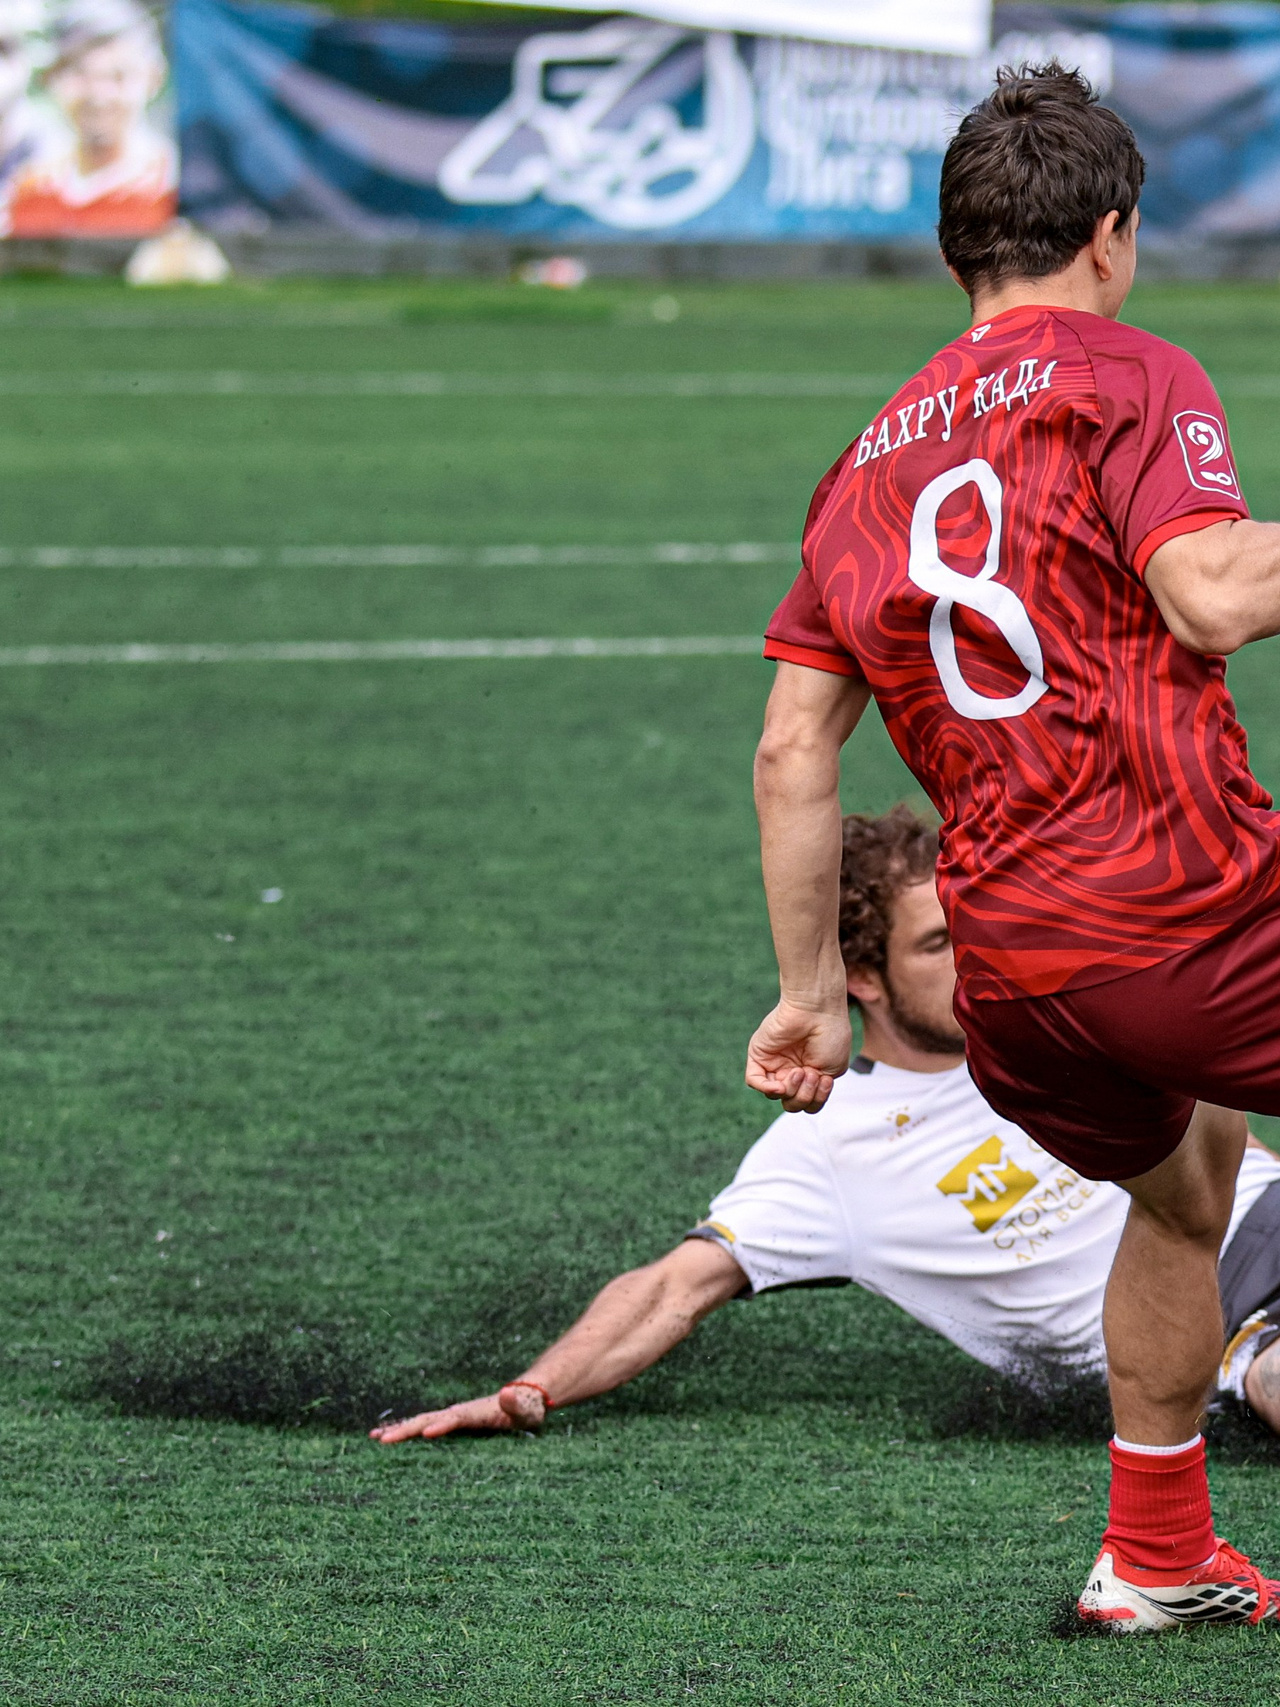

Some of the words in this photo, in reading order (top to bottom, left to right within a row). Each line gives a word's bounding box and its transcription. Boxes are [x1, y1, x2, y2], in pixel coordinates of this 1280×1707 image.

[853, 385, 959, 469] БАХРУ
[973, 358, 1058, 419] КАДА
[908, 458, 1049, 720] 8
[1055, 1181, 1100, 1223] ВСЕ
